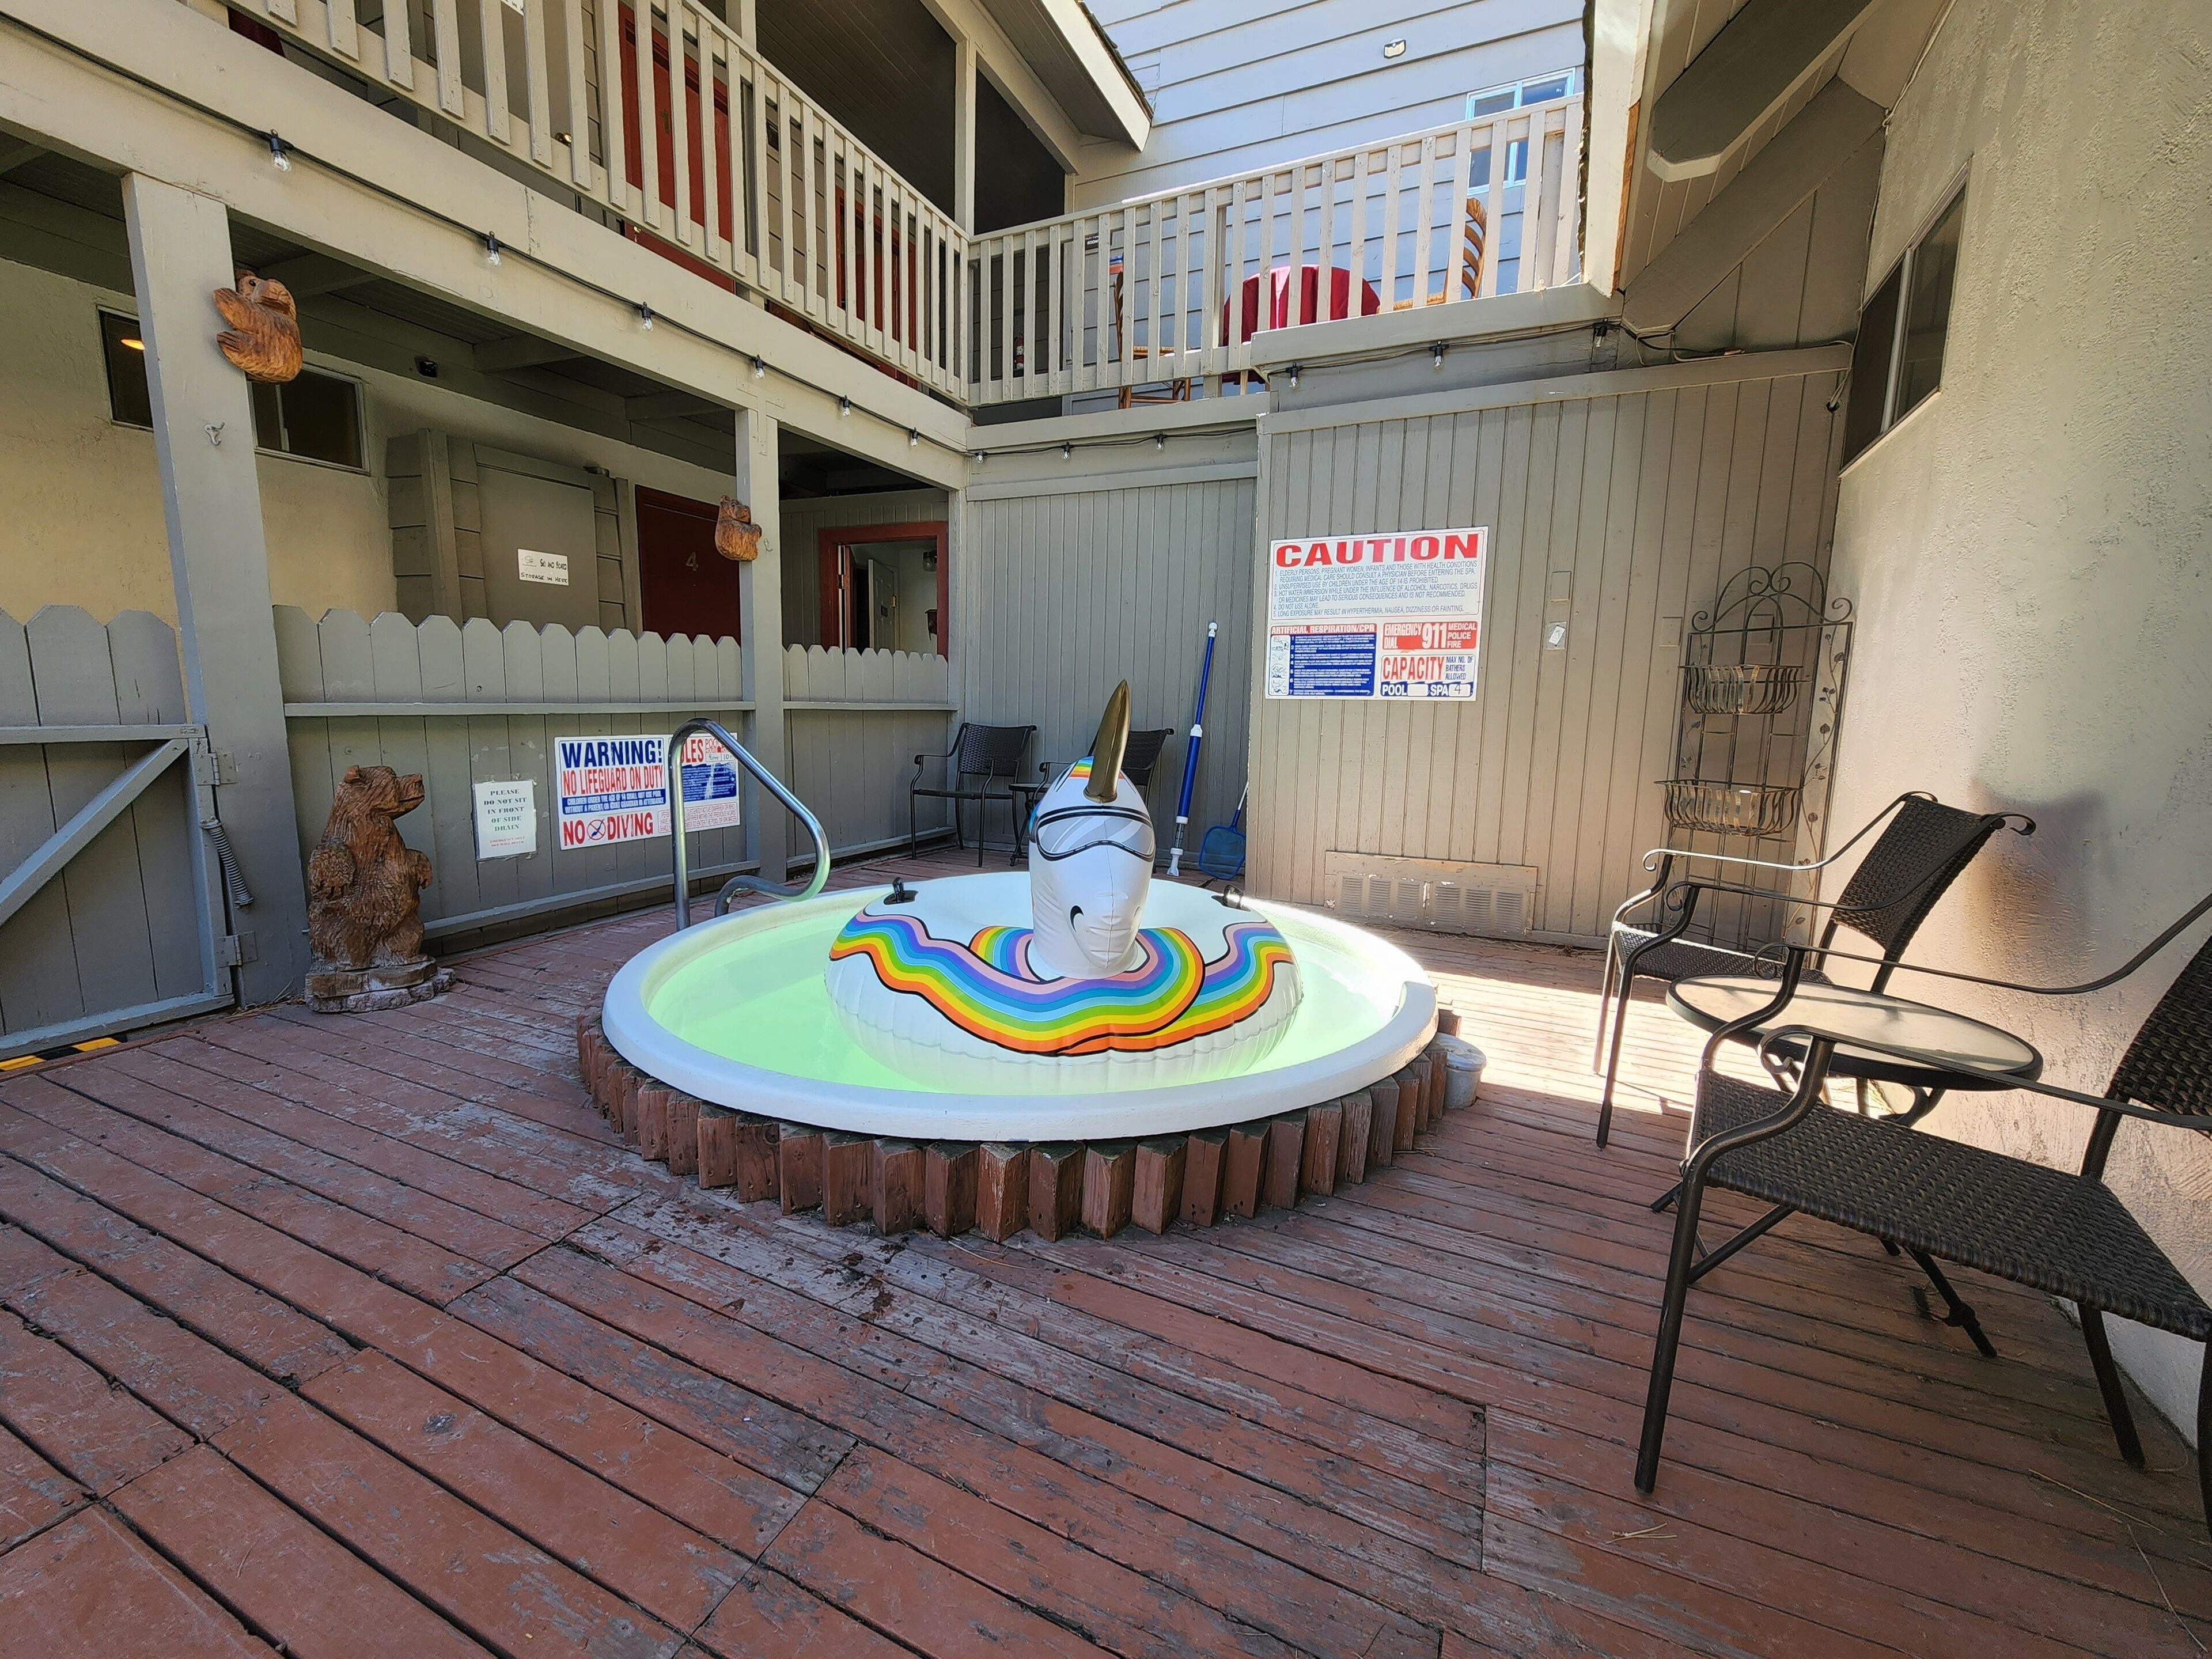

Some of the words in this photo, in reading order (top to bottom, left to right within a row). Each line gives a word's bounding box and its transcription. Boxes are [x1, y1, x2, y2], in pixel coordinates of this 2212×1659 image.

[1275, 533, 1479, 567] CAUTION
[686, 552, 699, 571] 4
[521, 572, 544, 580] STORAGE
[1279, 582, 1312, 590] UNSUPERVISED
[1359, 592, 1398, 600] CONSEQUENCES
[1271, 626, 1308, 634] ARTIFICIAL
[1311, 624, 1376, 633] RESPIRATION/CPR
[1385, 623, 1422, 636] EMERGENCY
[1448, 622, 1477, 630] MEDICAL
[1422, 623, 1447, 649] 911
[1448, 631, 1471, 639] POLICE
[1384, 637, 1399, 649] DIAL
[1383, 656, 1445, 680] CAPACITY
[1382, 684, 1407, 696] POOL
[1430, 683, 1449, 696] SPA
[1454, 684, 1461, 695] 4
[561, 740, 662, 768] WARNING!
[681, 739, 704, 763] LES
[563, 770, 577, 796] NO
[579, 767, 627, 795] LIFEGUARD
[630, 766, 641, 790] ON
[643, 765, 663, 789] DUTY
[494, 824, 520, 832] DRAIN
[563, 819, 585, 846] NO
[607, 812, 653, 840] DIVING
